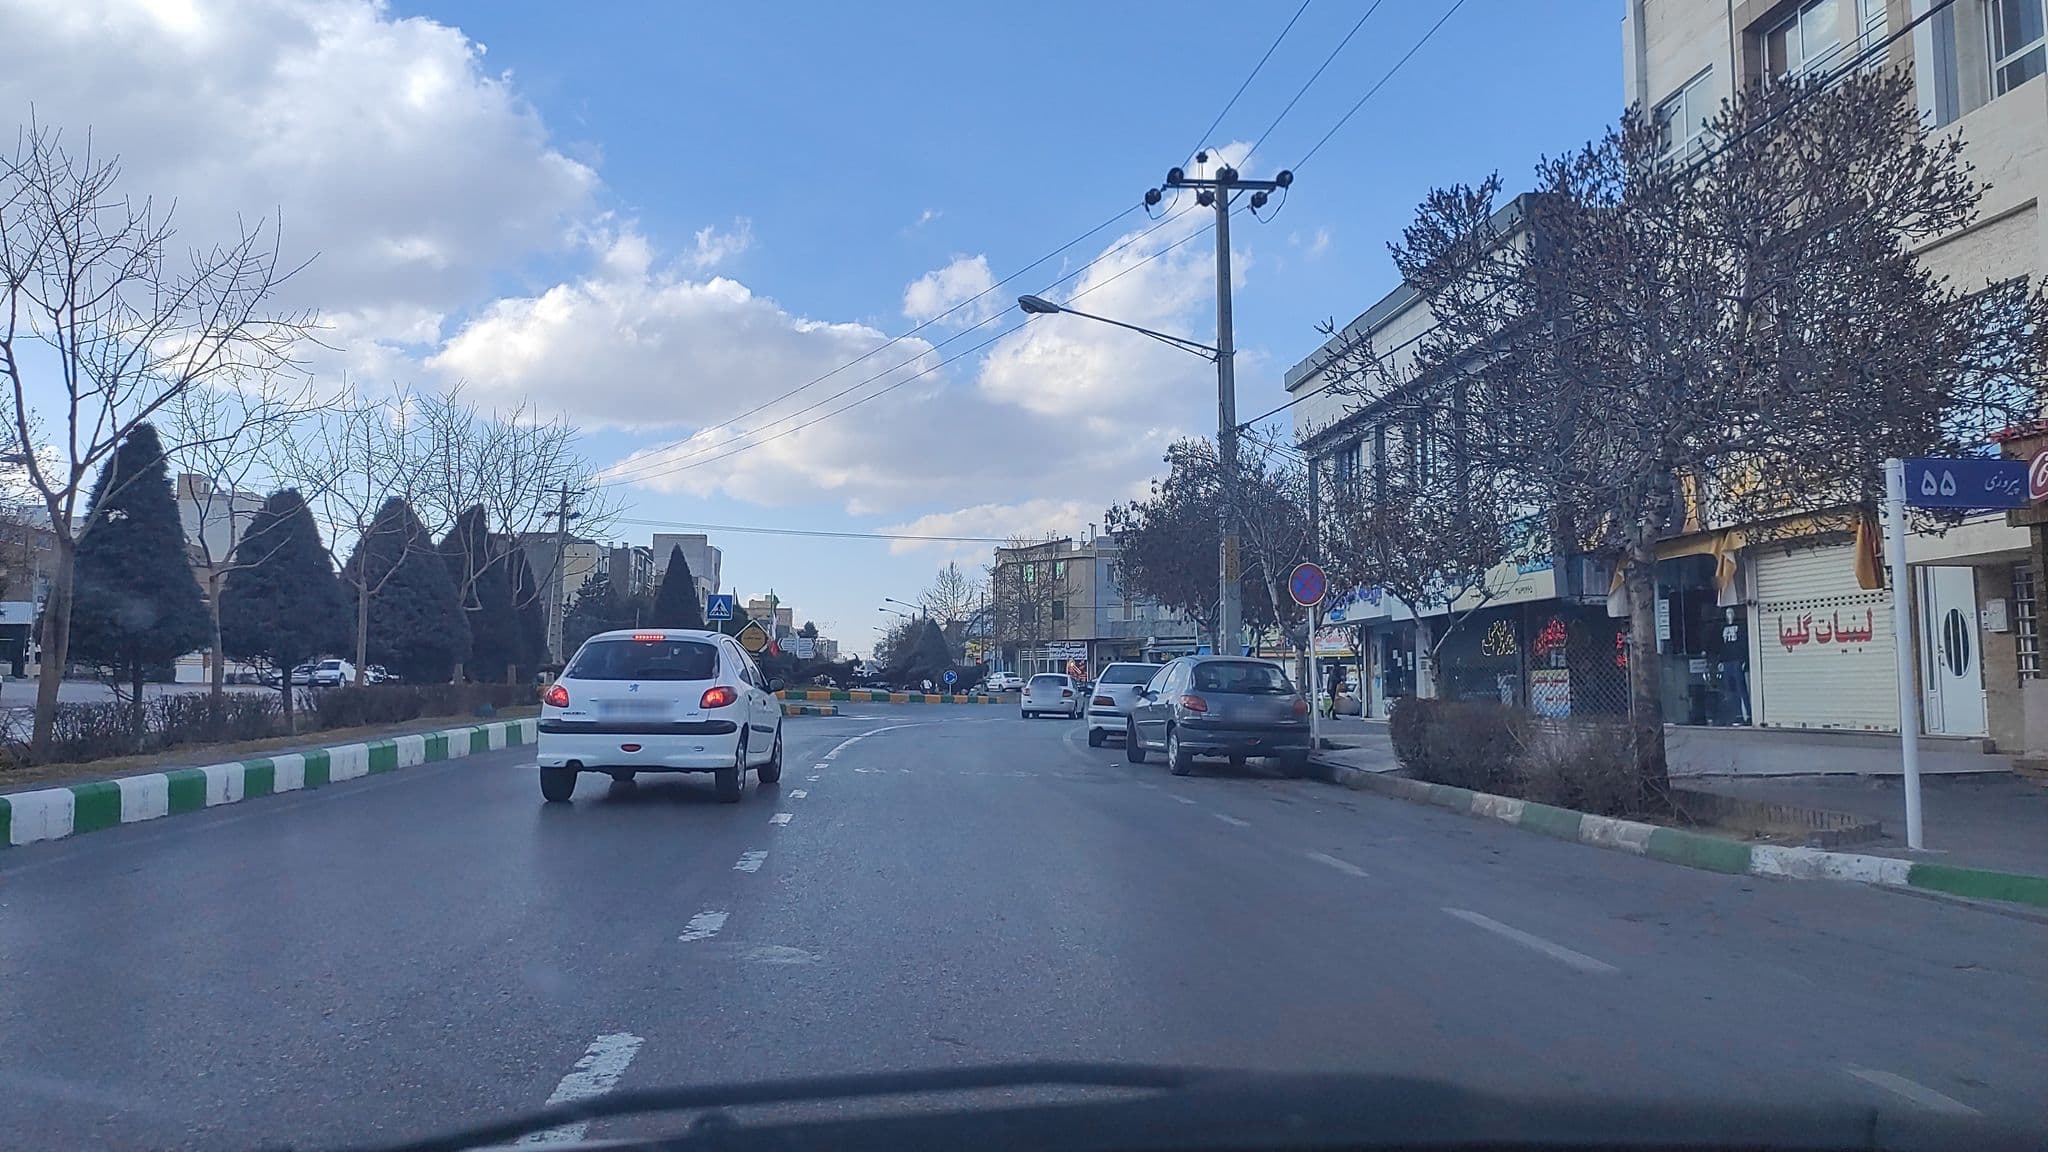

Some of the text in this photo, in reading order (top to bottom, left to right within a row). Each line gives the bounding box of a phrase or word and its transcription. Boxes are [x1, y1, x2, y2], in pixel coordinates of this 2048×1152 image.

[1920, 469, 1957, 497] ۵۵
[1984, 470, 2020, 496] پیروزی
[1778, 611, 1813, 654] گلها
[1815, 606, 1873, 654] لبنیات
